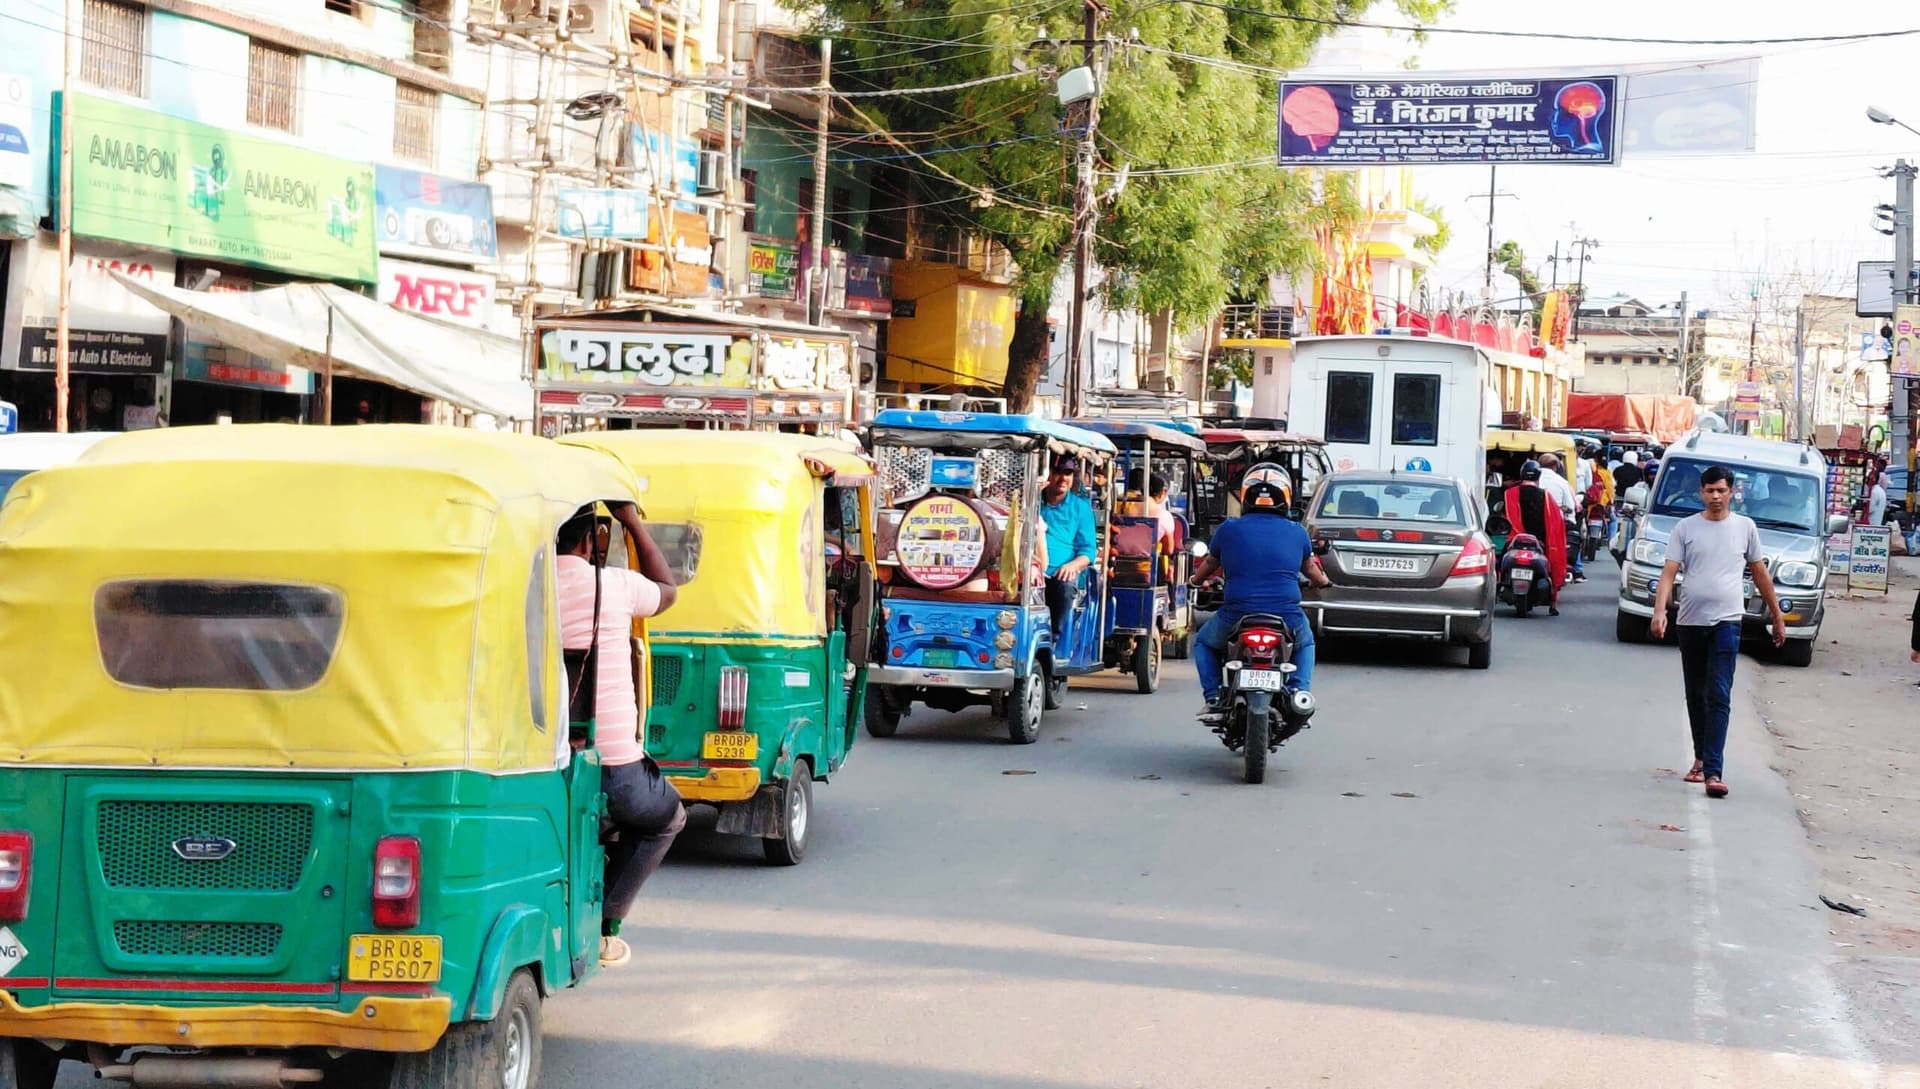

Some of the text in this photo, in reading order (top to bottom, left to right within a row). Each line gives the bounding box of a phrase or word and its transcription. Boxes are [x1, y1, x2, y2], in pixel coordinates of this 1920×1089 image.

[1351, 99, 1537, 128] डॉ. निरंजन कुमार
[89, 134, 177, 181] AMARON
[244, 169, 318, 210] AMARON
[393, 273, 487, 317] MRF
[79, 347, 99, 364] Auto
[100, 349, 108, 364] &
[110, 349, 153, 367] Electricals
[556, 329, 732, 386] फालुदा
[714, 734, 751, 746] BR08P
[716, 747, 745, 758] 5238
[369, 960, 433, 980] P5607
